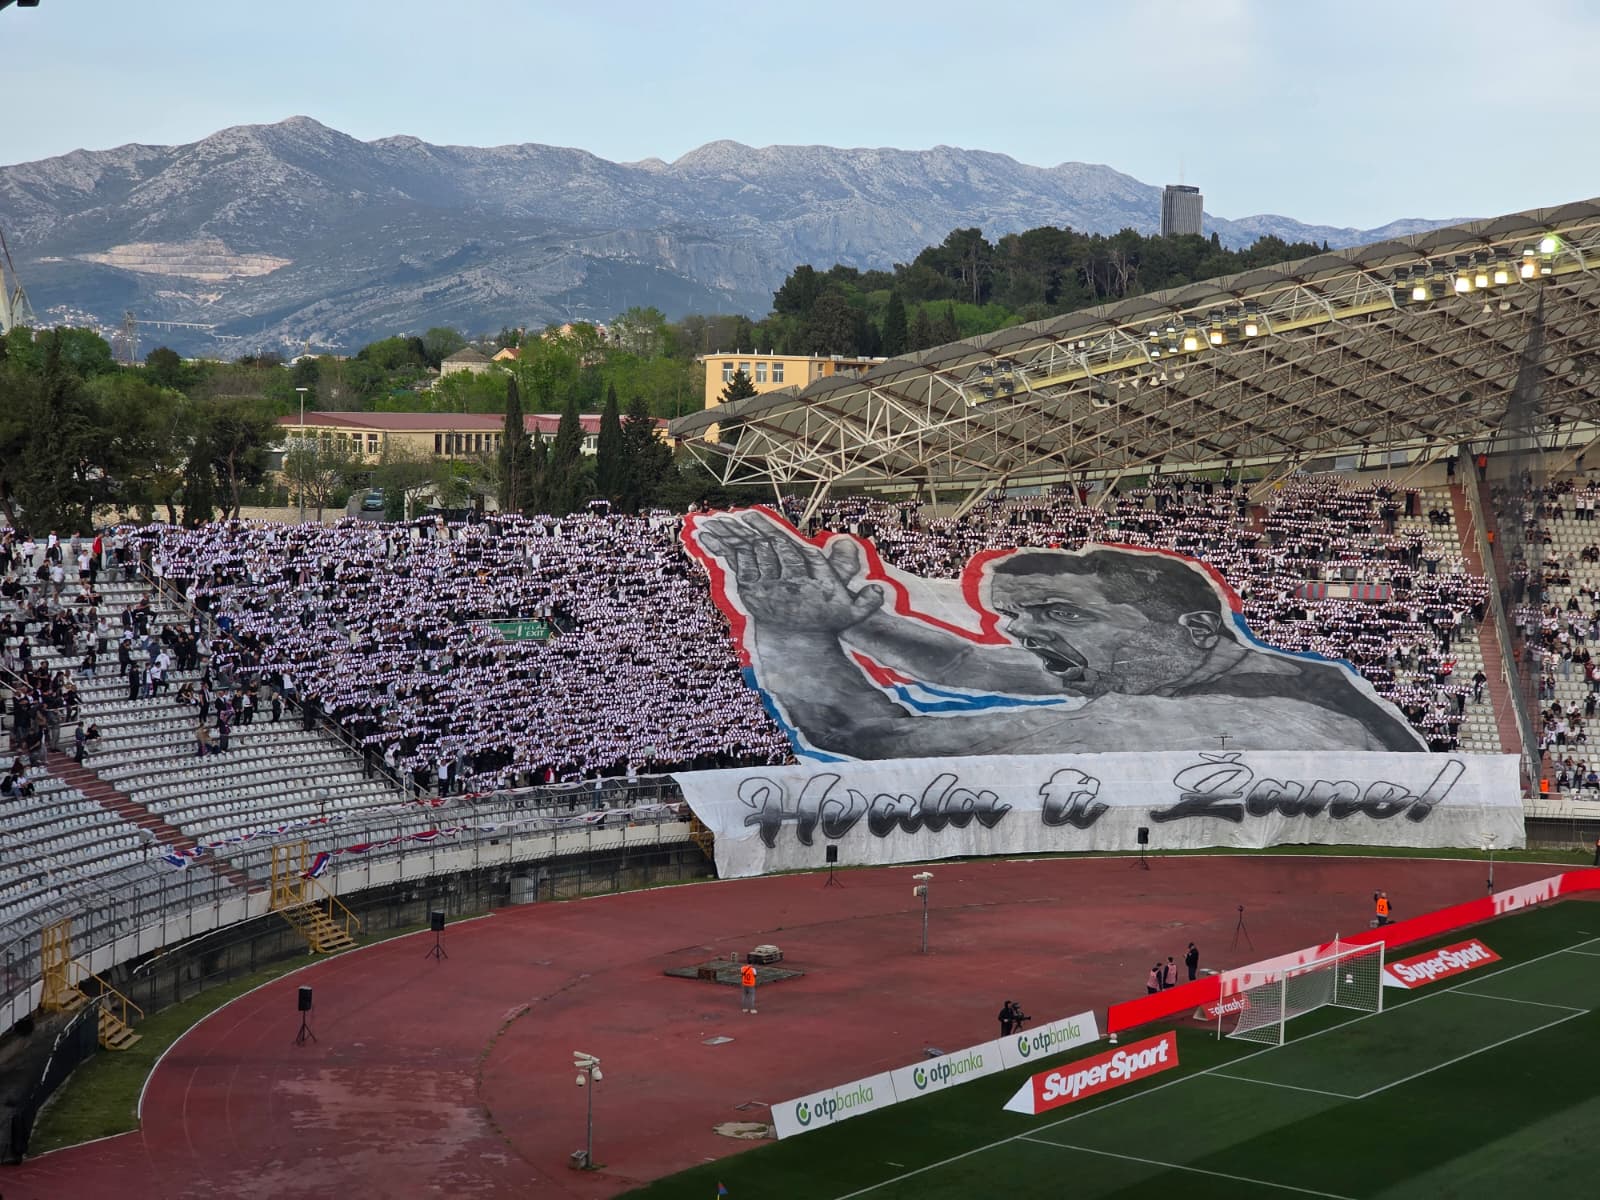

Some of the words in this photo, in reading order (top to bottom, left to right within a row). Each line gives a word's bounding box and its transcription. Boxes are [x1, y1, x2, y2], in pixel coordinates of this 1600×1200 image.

[738, 772, 1012, 849] Hvala
[1038, 768, 1109, 829] ti
[1150, 752, 1466, 823] Žane!
[1393, 943, 1491, 982] SuperSport
[1033, 1021, 1081, 1052] otpbanka
[930, 1051, 983, 1084] otpbanka
[1042, 1039, 1168, 1101] SuperSport
[814, 1084, 874, 1120] otpbanka
